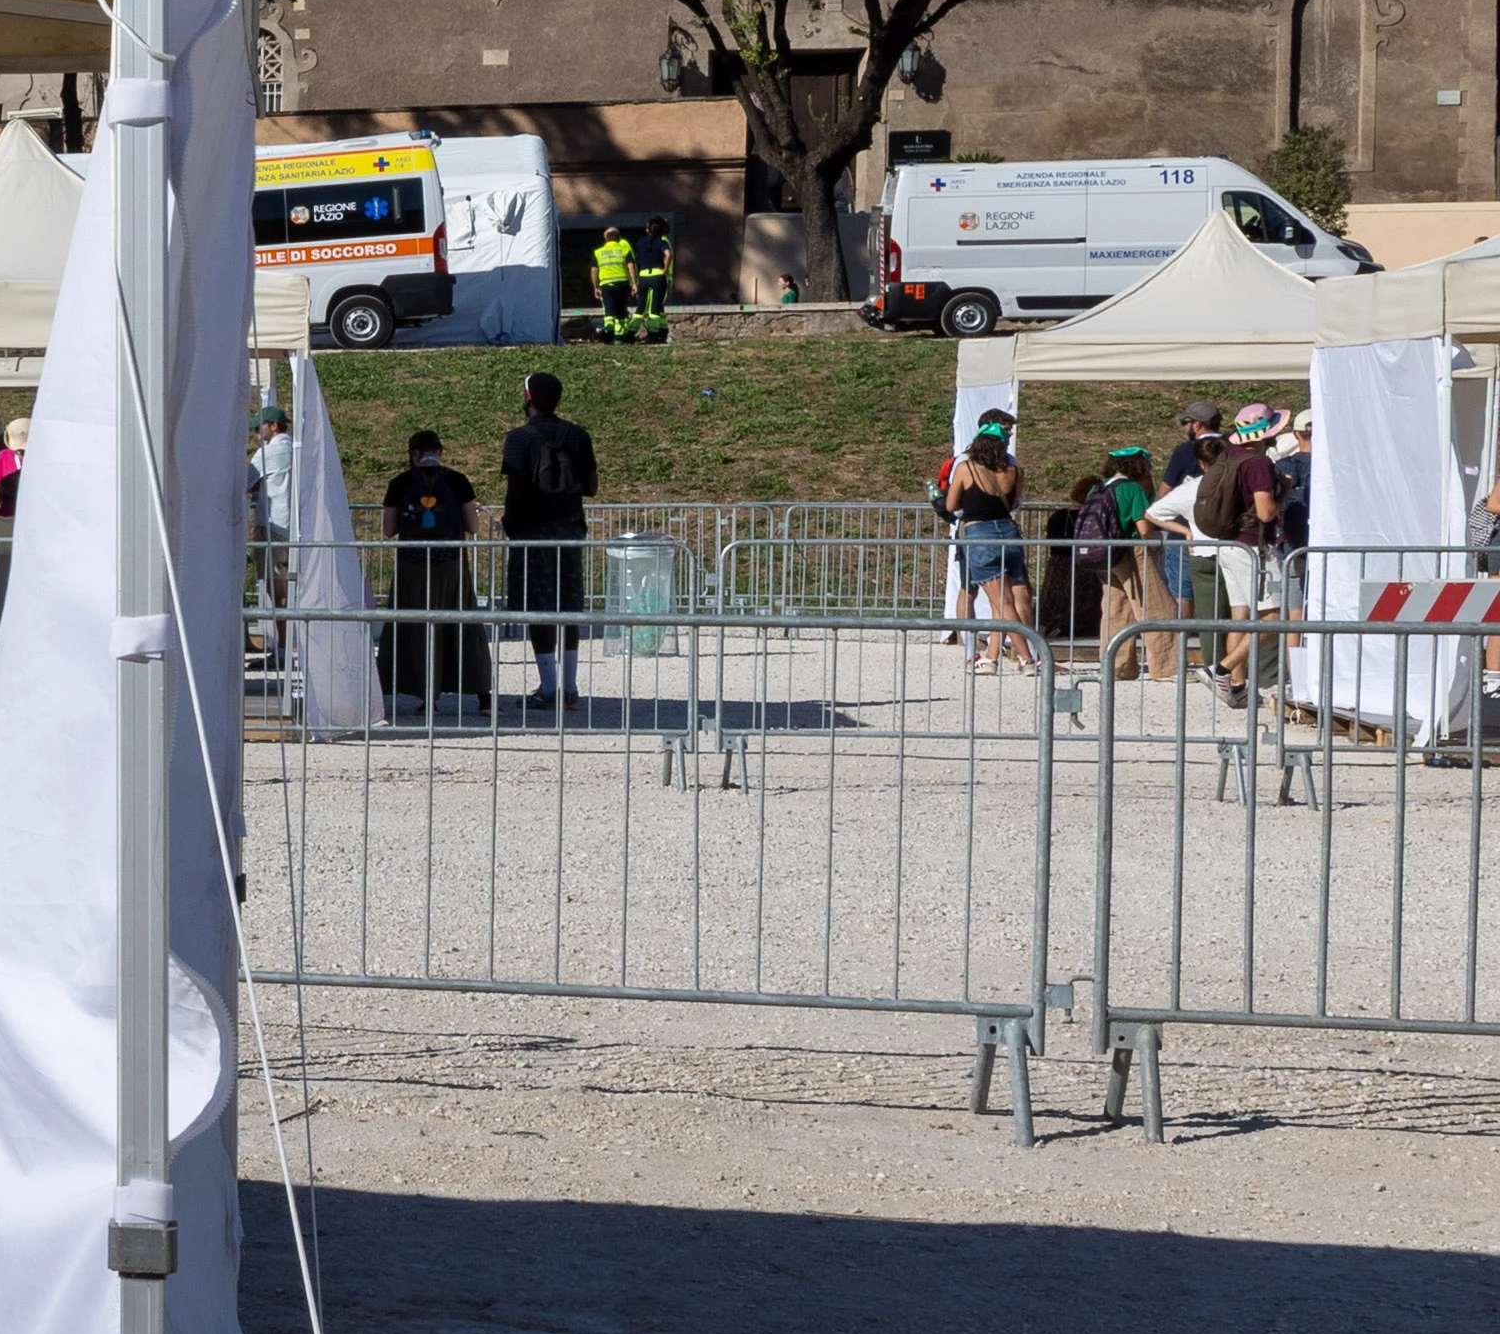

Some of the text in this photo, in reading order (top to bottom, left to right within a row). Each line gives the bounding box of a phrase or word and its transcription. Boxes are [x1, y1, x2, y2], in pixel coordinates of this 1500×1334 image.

[283, 159, 336, 169] REGIONALE
[279, 170, 325, 180] SANITARIA
[328, 167, 355, 176] LAZIO
[1016, 170, 1194, 184] AZIENDA REGIONALE 118
[997, 178, 1126, 188] EMERGENZA SANITARIA LAZIO
[313, 201, 357, 214] REGIONE
[313, 212, 344, 222] LAZIO
[986, 211, 1035, 221] REGIONE
[985, 220, 1020, 231] LAZIO
[290, 250, 306, 262] DI
[310, 243, 397, 260] SOCCORSO
[1089, 249, 1177, 259] MAXIEMERGENZ
